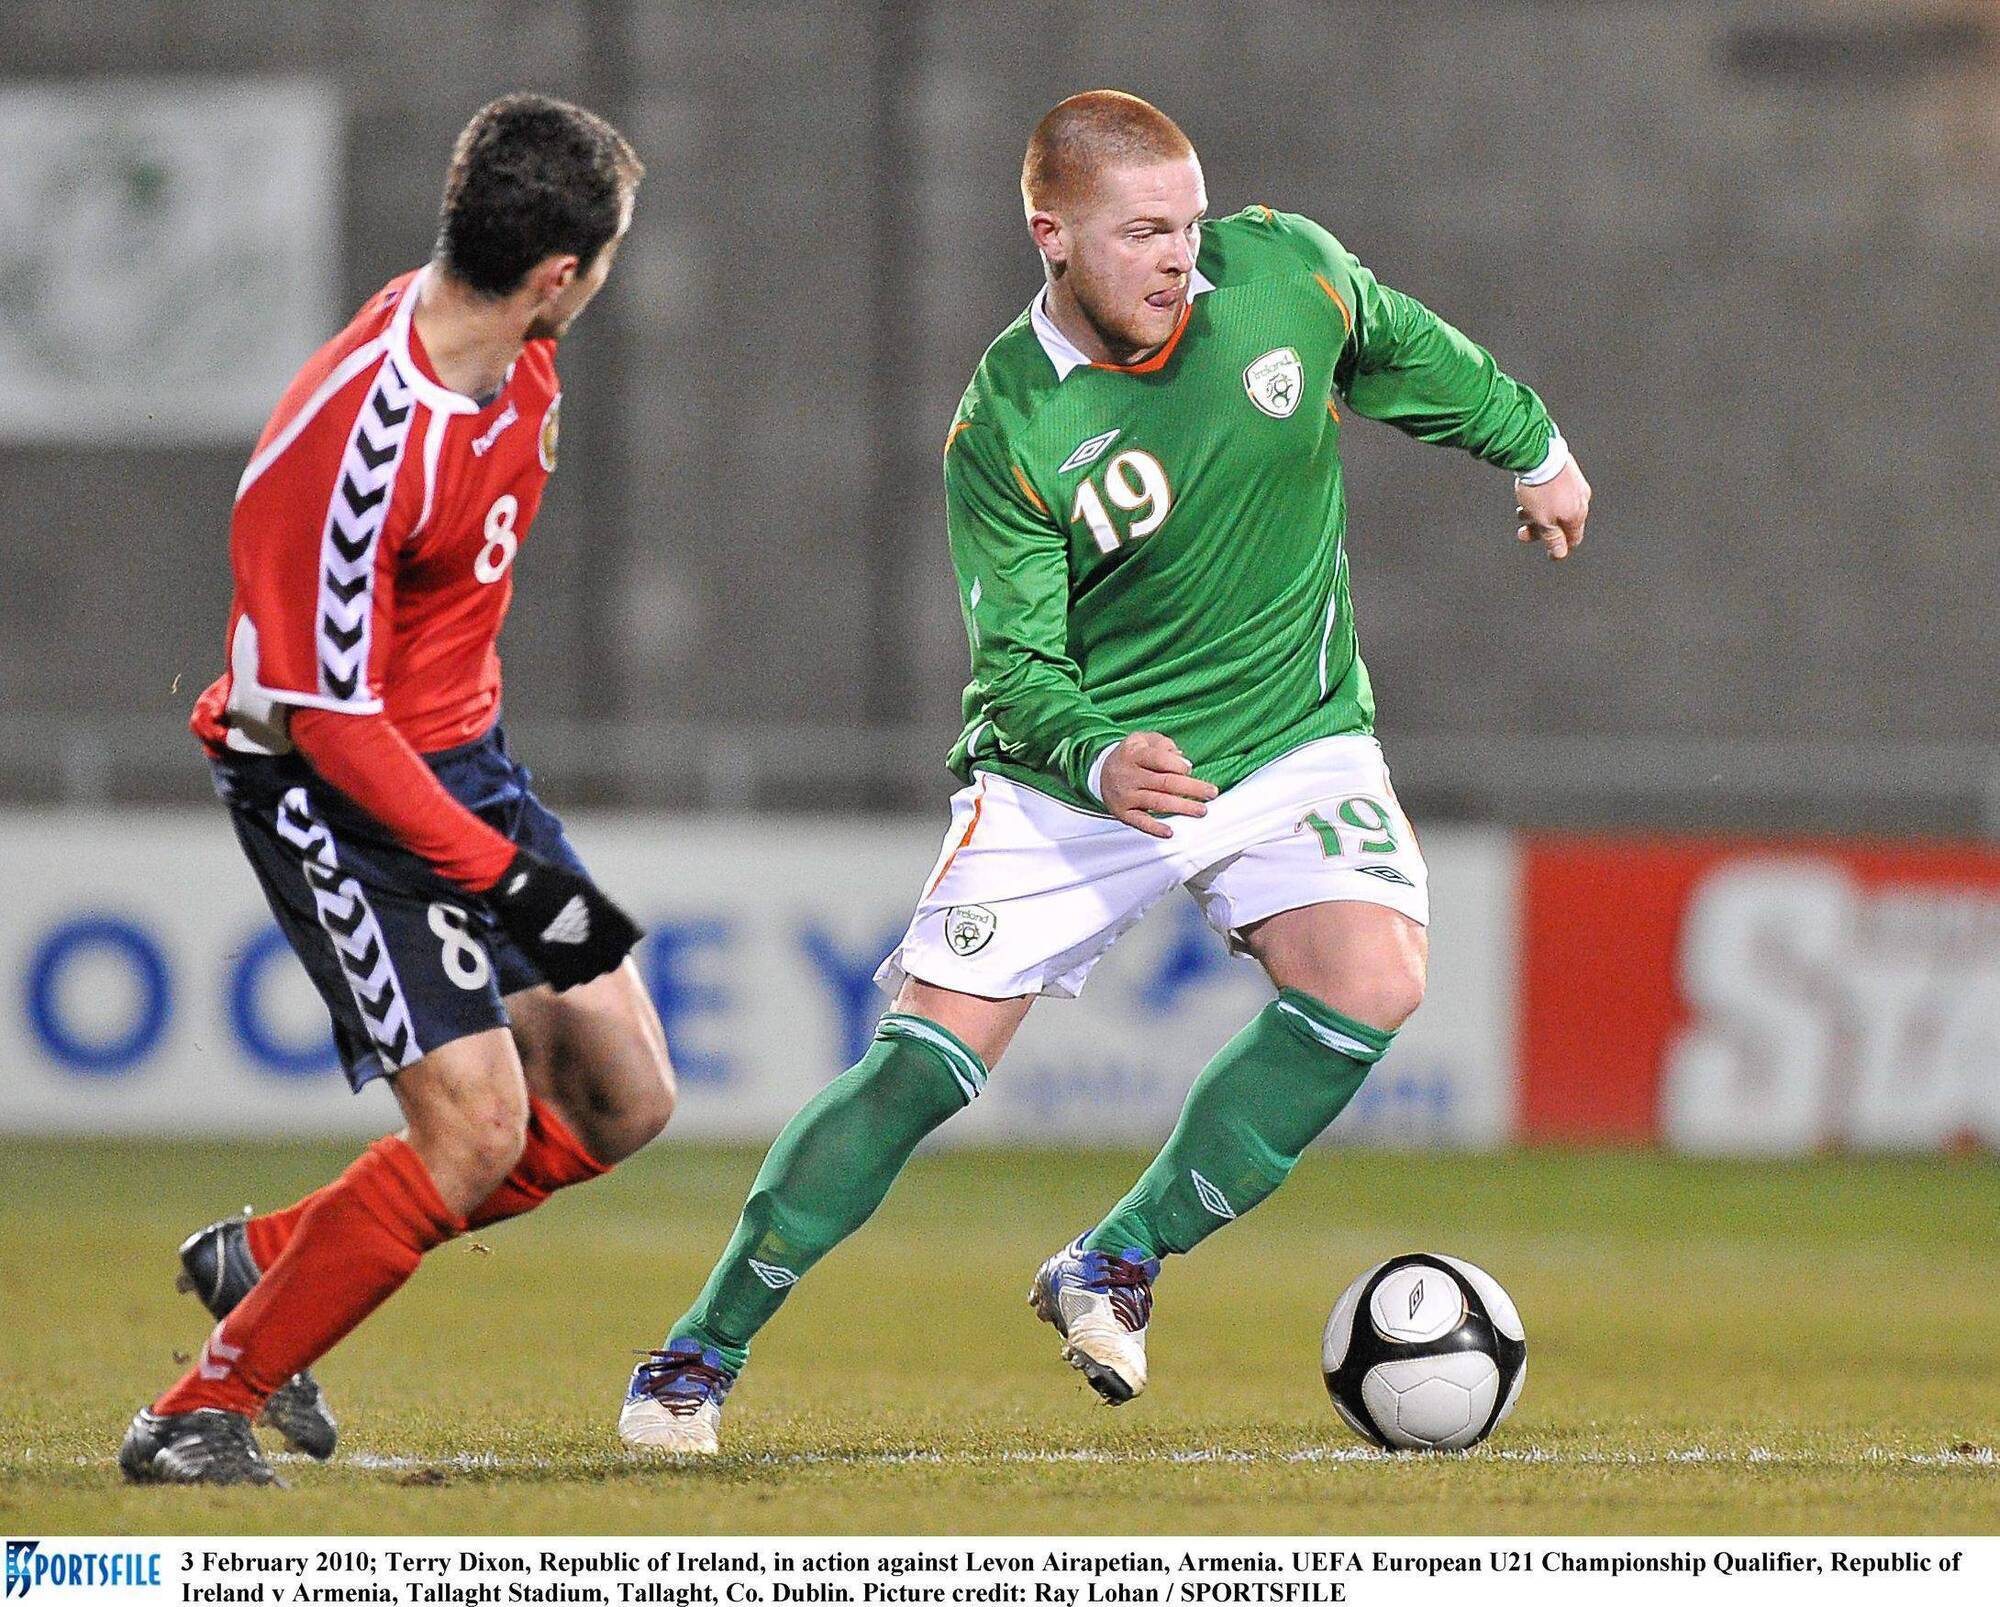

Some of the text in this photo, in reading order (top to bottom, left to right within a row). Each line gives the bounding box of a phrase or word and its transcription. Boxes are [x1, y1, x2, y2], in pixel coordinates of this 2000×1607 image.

[474, 494, 518, 584] 8
[1071, 448, 1172, 555] 19
[1294, 797, 1398, 860] 19
[427, 902, 490, 990] 8
